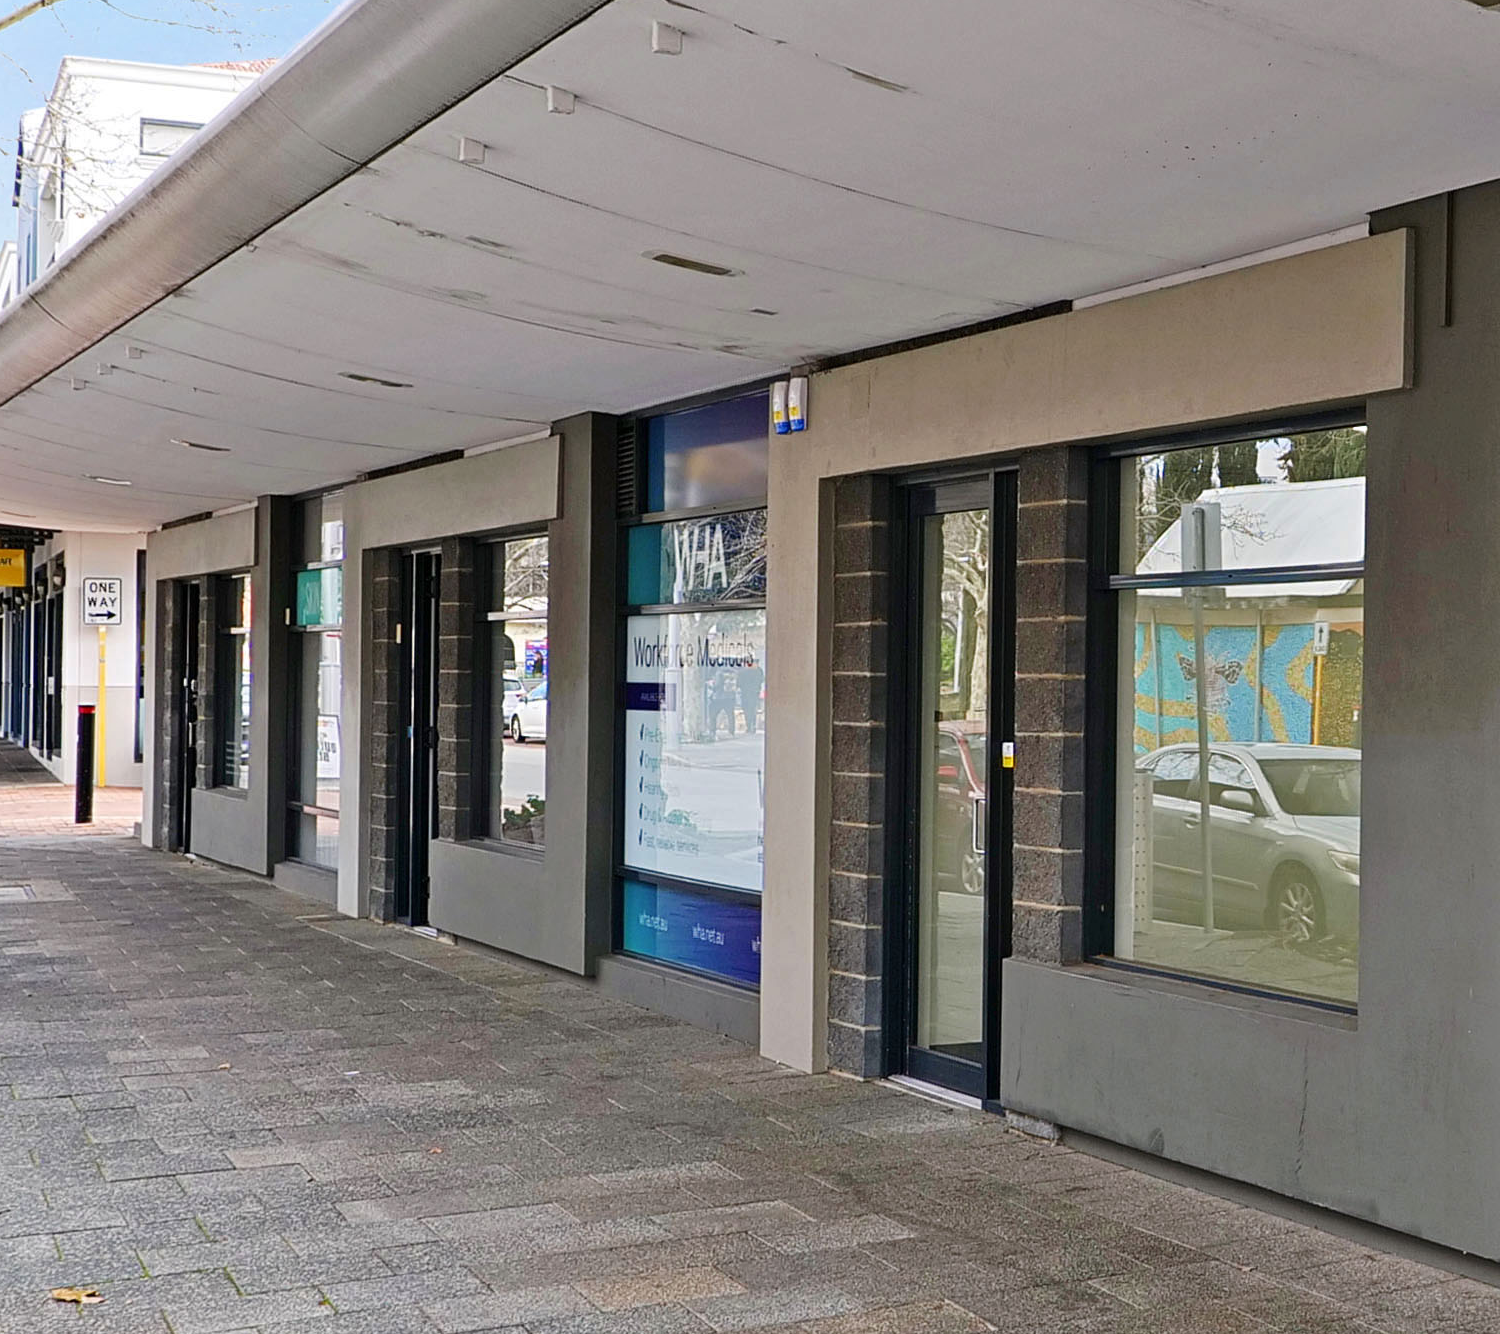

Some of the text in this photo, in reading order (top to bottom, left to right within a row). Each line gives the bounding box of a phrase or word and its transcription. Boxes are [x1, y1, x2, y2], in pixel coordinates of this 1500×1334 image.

[673, 523, 728, 590] WHA
[90, 582, 116, 593] ONE
[88, 597, 117, 607] WAY
[697, 633, 754, 667] Medicals
